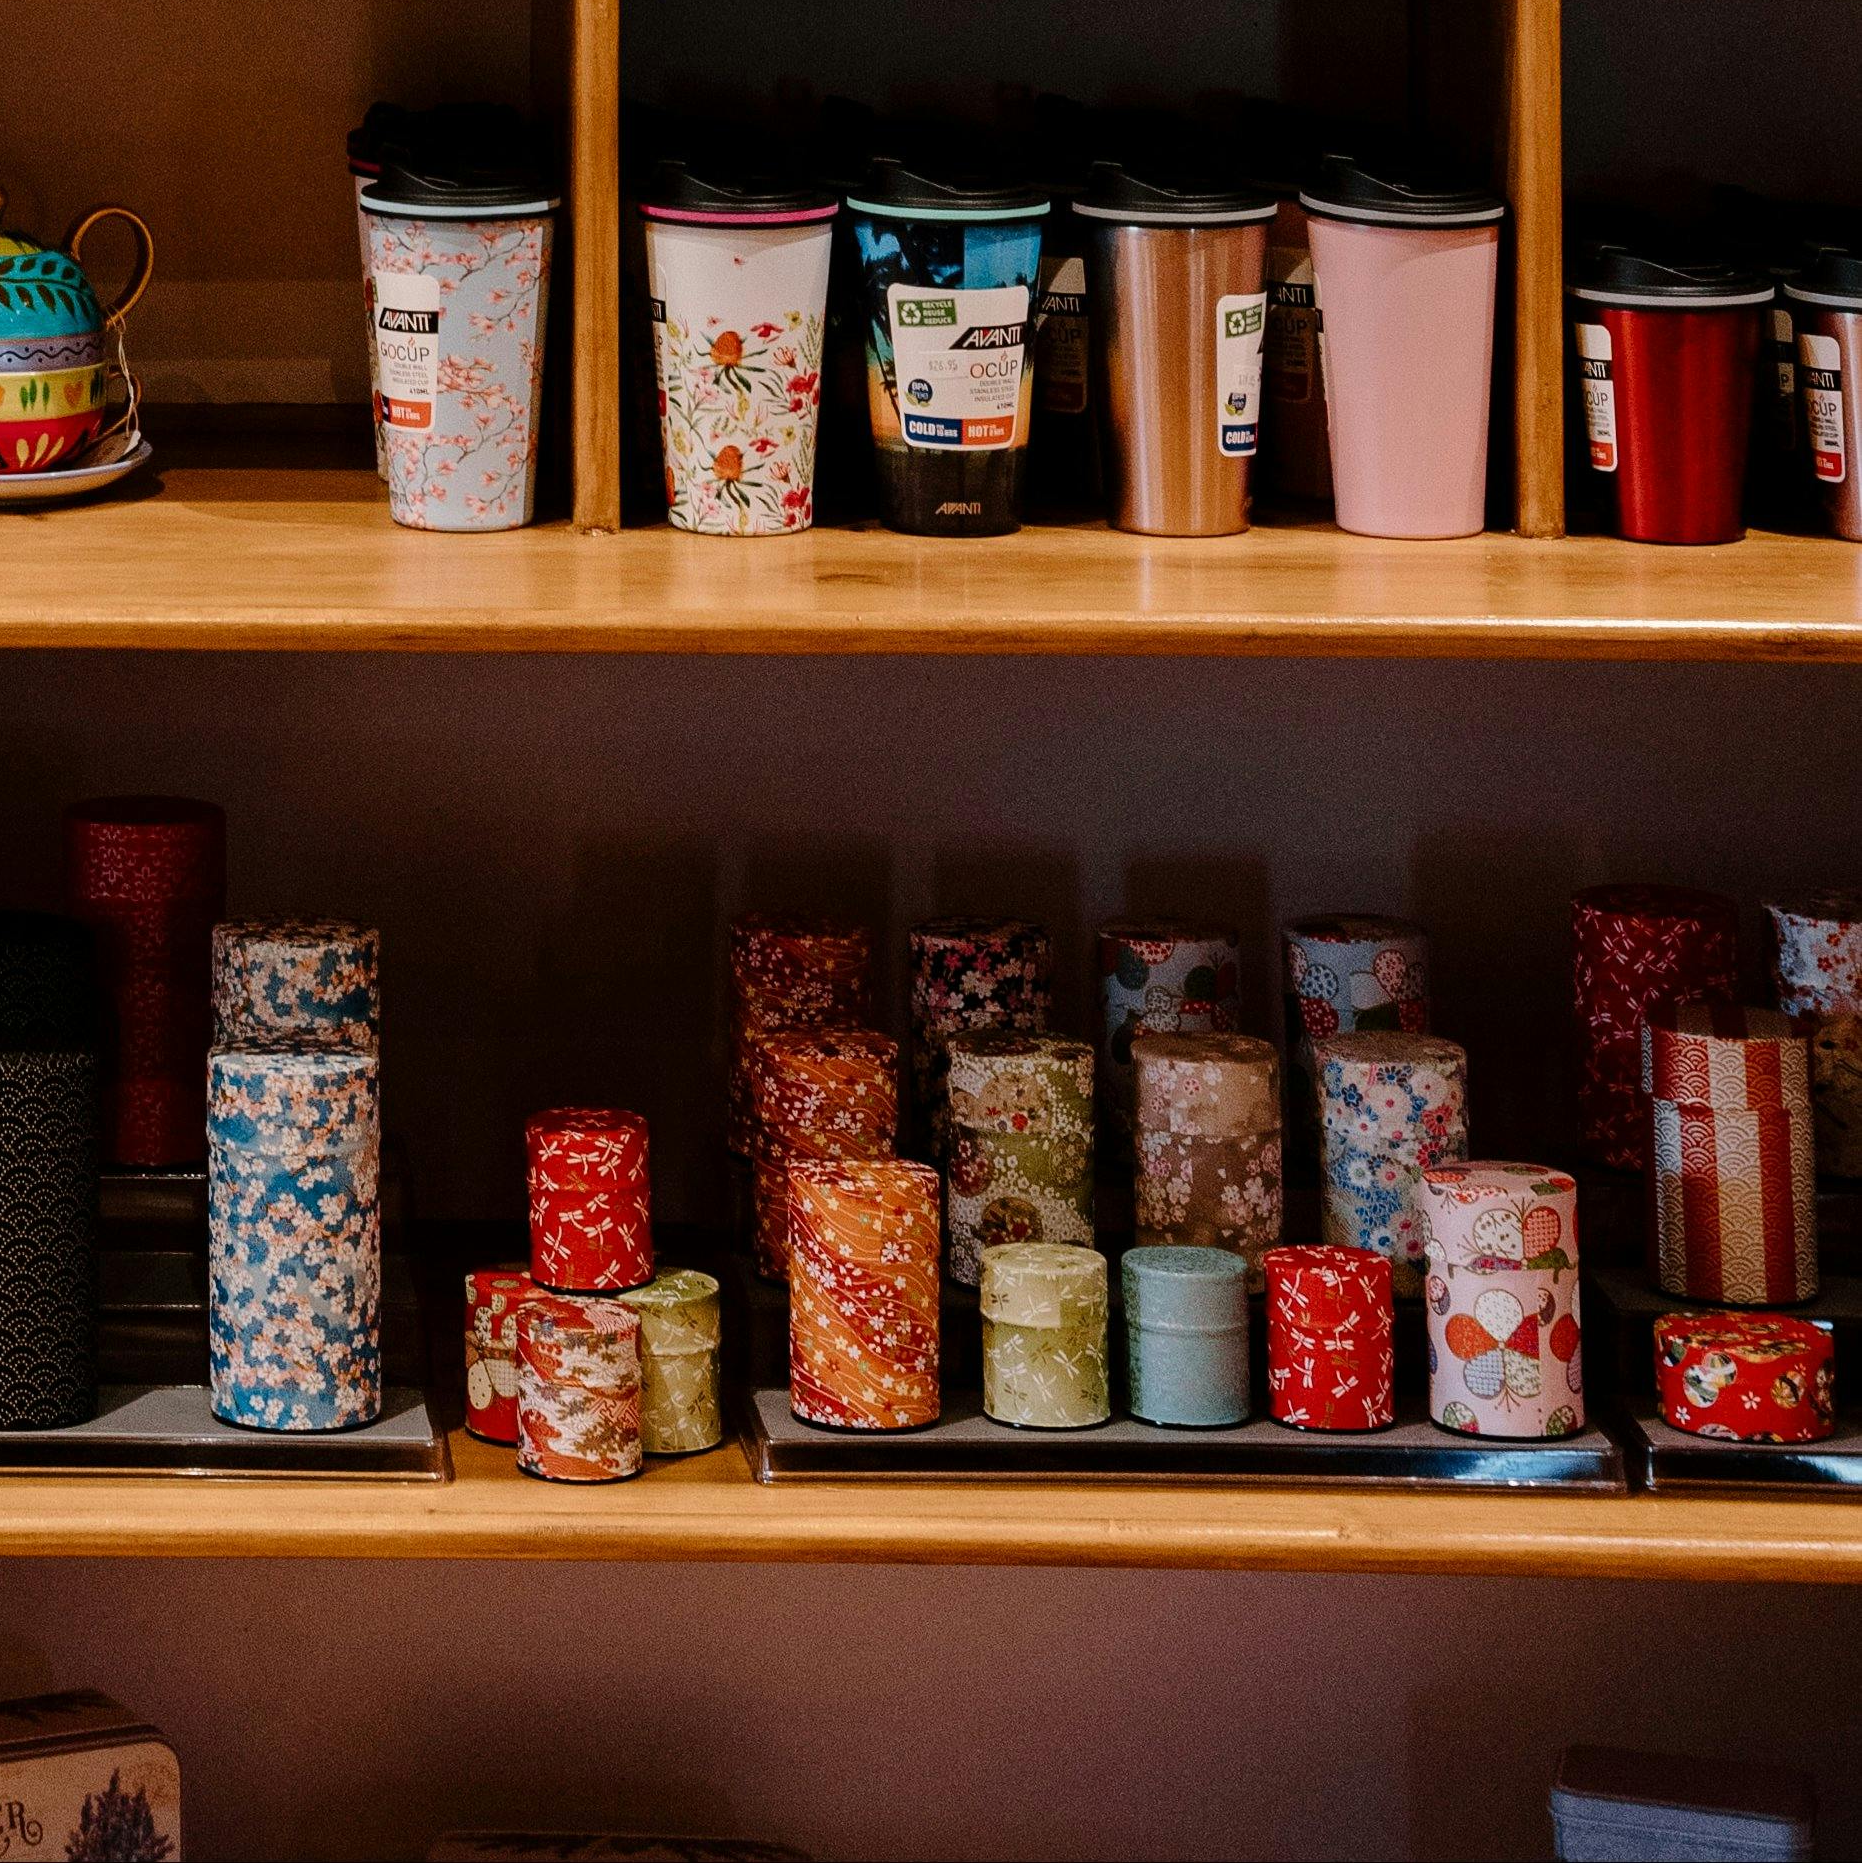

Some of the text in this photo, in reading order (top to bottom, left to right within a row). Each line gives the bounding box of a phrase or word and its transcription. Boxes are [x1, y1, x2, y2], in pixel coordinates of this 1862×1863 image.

[382, 311, 429, 331] AVANTI
[963, 327, 1021, 348] AVANTI
[381, 343, 429, 362] GOCUP
[909, 421, 936, 436] COLD
[935, 502, 981, 514] AVANTI
